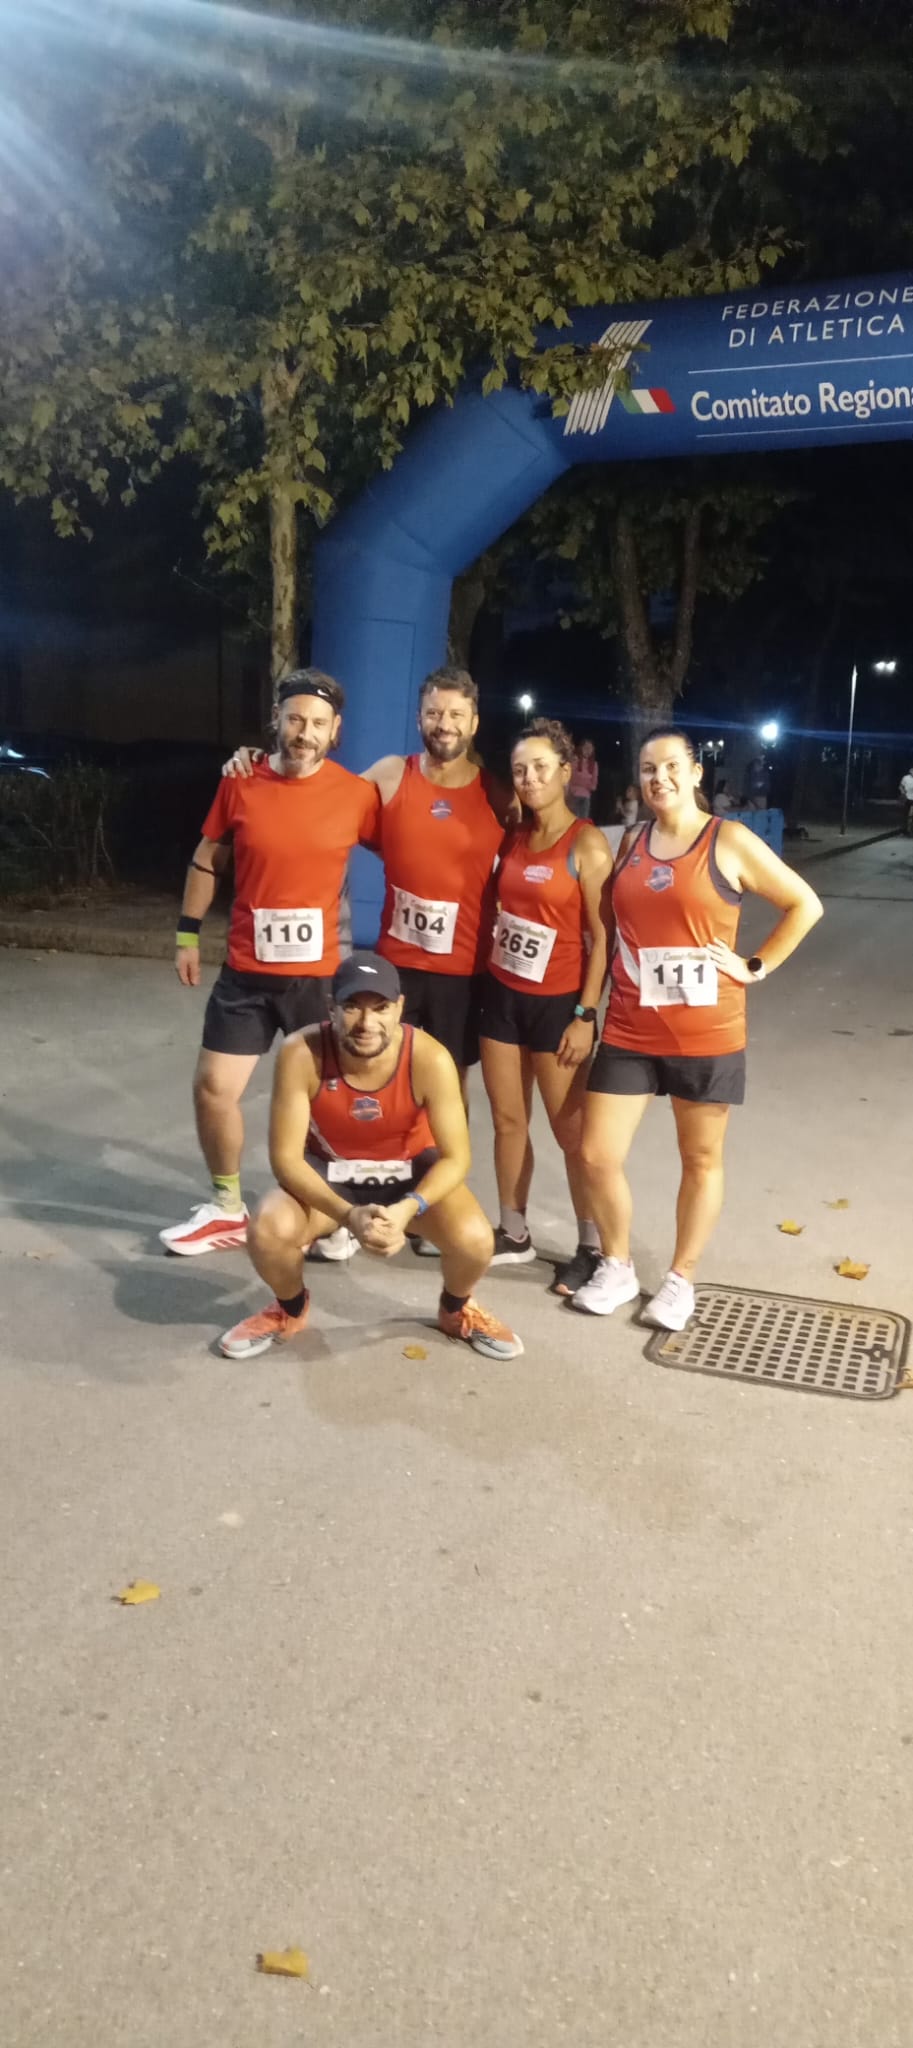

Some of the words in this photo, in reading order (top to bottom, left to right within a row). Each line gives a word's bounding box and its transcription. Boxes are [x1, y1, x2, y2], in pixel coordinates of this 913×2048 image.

[721, 287, 913, 321] FEDERAZIONE
[729, 326, 755, 348] DI
[768, 314, 905, 344] ATLETICA
[690, 388, 811, 421] Comitato
[818, 380, 913, 419] Region
[262, 923, 312, 943] 110
[402, 907, 445, 934] 104
[499, 928, 540, 958] 265
[653, 964, 704, 984] 111
